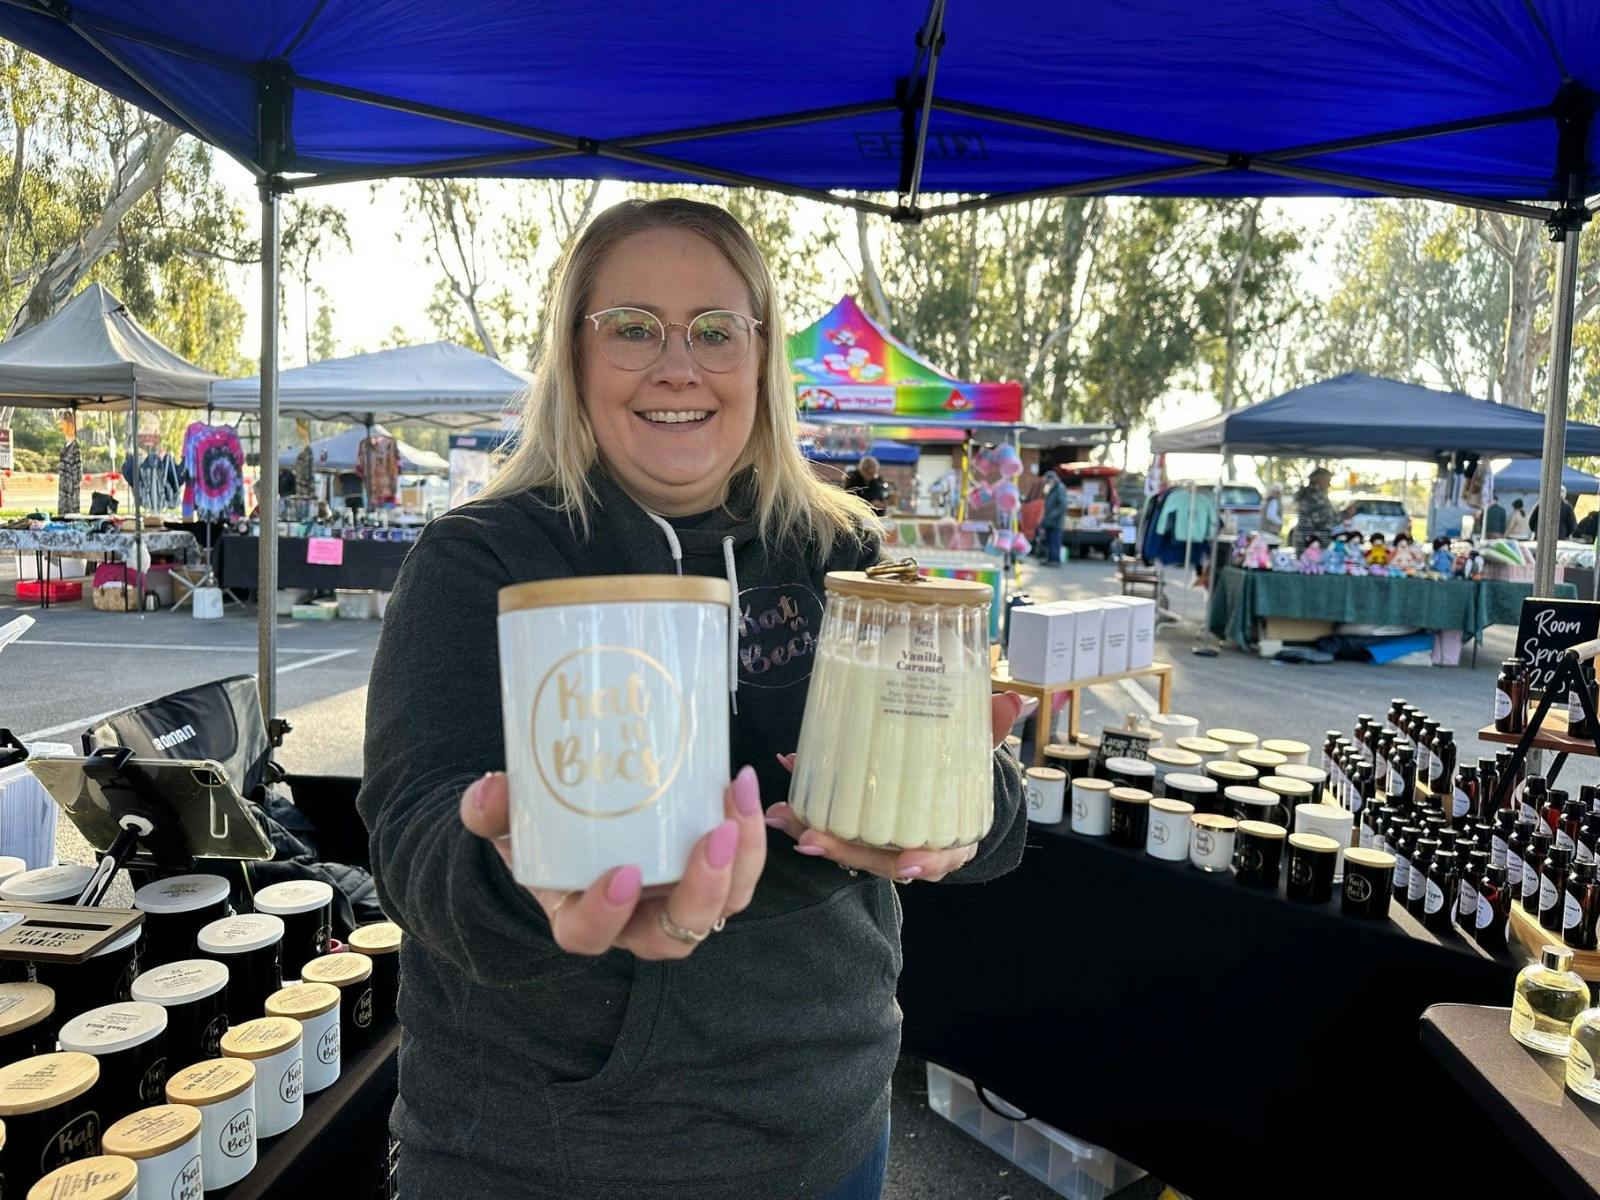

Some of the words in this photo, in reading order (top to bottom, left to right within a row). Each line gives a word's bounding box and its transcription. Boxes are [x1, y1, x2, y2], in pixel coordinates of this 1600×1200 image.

[739, 595, 799, 637] Kat
[1535, 609, 1581, 637] Room
[896, 660, 946, 674] Caramel
[902, 649, 944, 663] Vanilla
[557, 671, 650, 721] Kat
[152, 724, 196, 751] ROMAN
[552, 736, 666, 788] Becs
[10, 937, 66, 948] CANDLES
[15, 930, 42, 938] KAT
[50, 932, 84, 941] BECS
[59, 1119, 95, 1154] Kat
[230, 1114, 250, 1135] Kat
